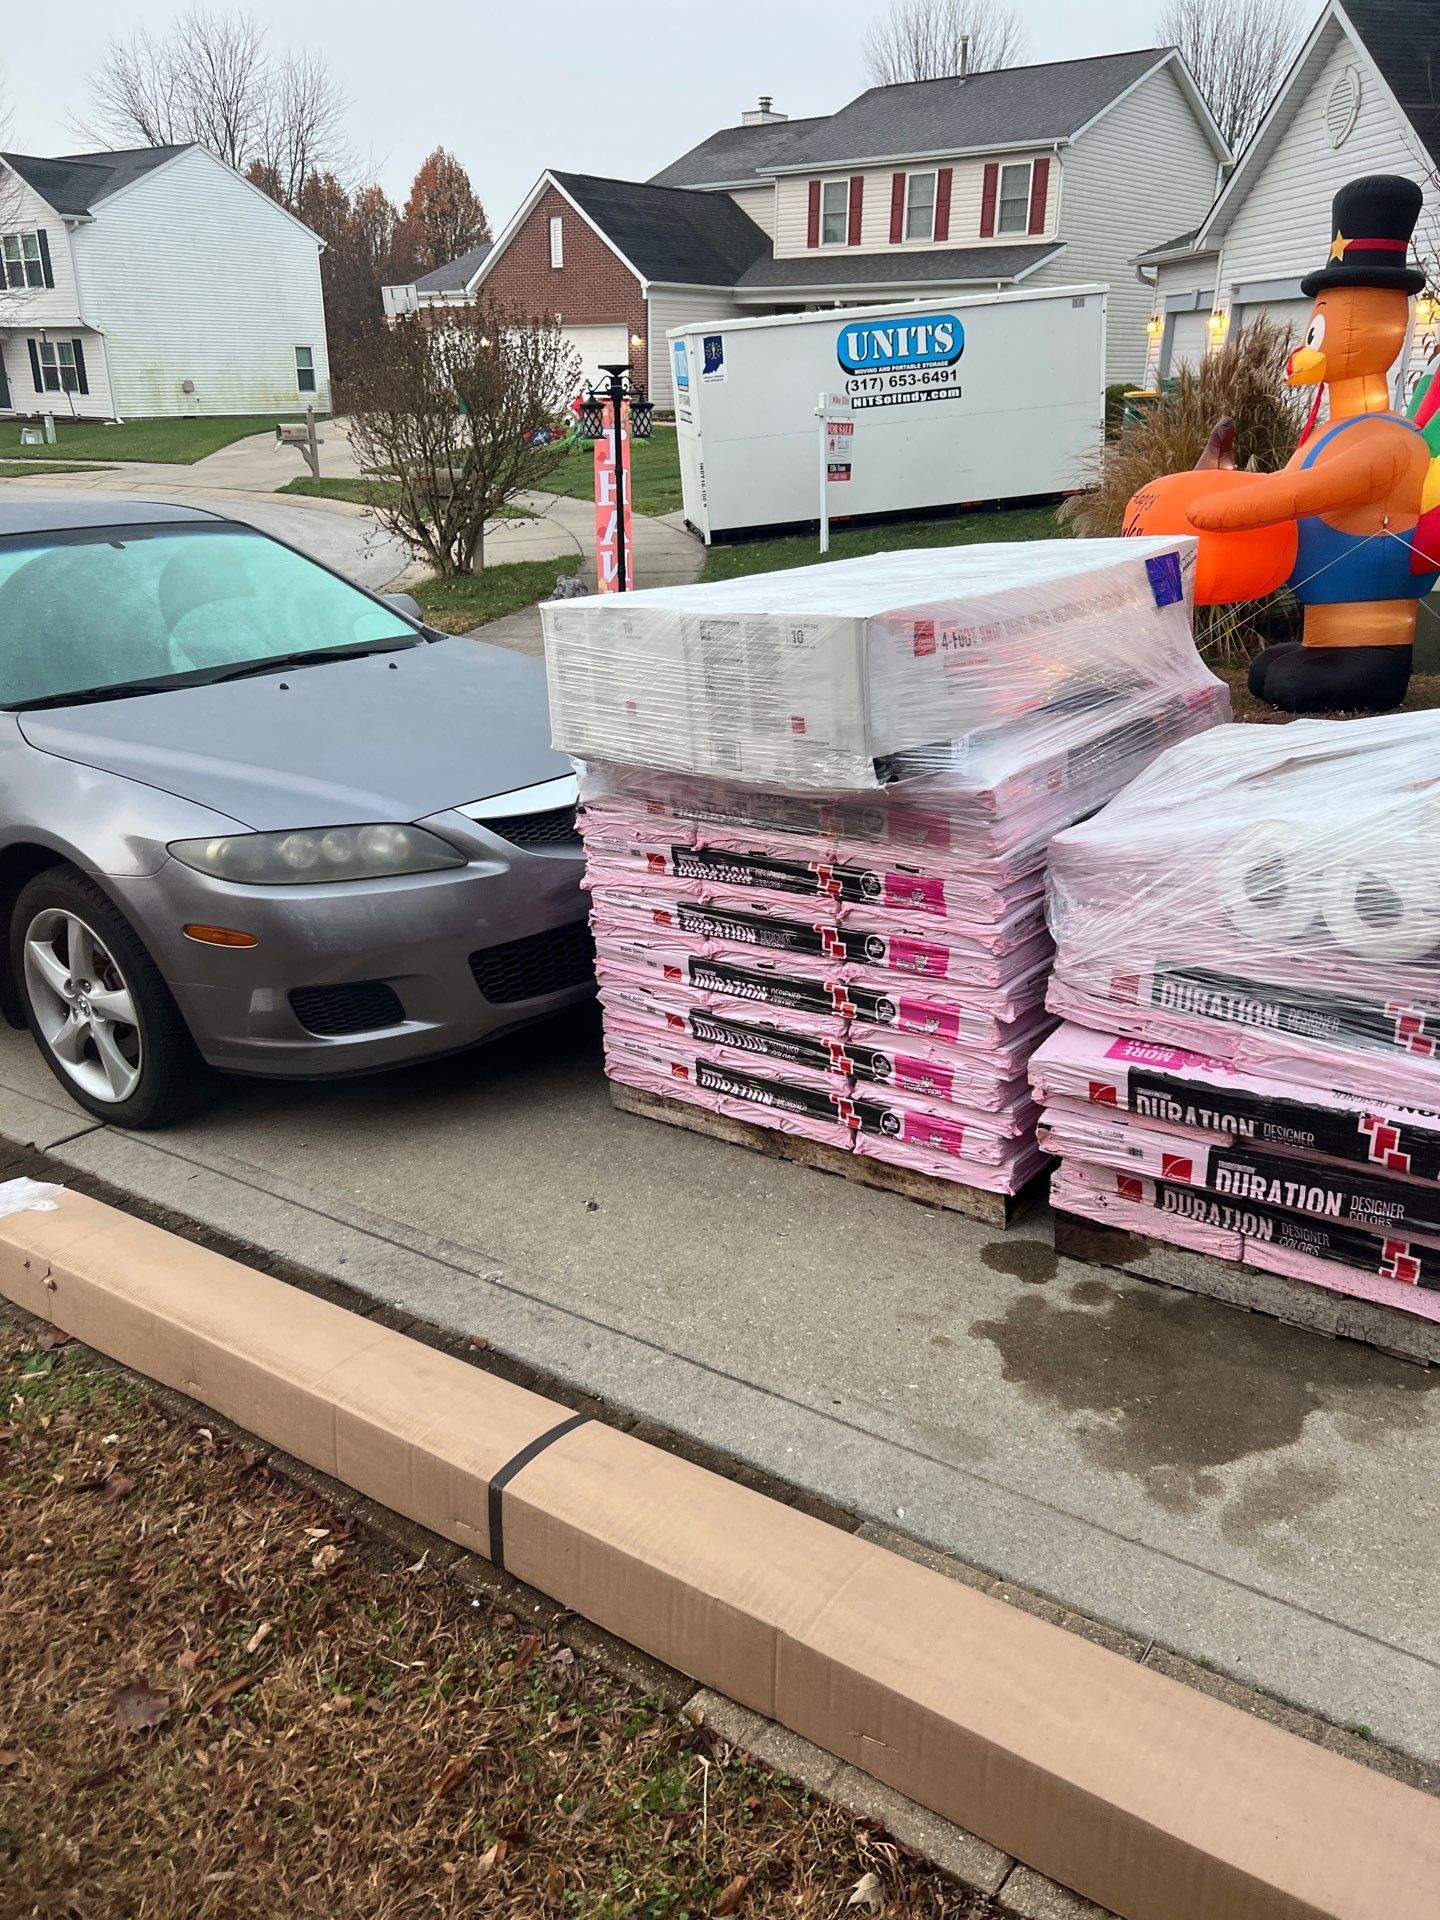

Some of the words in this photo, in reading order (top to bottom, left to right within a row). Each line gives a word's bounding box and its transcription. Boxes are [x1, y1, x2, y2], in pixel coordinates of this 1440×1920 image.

[846, 321, 954, 361] UNITS
[845, 377, 884, 395] (317)
[888, 369, 958, 388] 653-6491
[854, 367, 878, 376] MOVING
[879, 366, 891, 374] AND
[891, 363, 921, 373] PORTABLE
[921, 360, 949, 370] STORAGE
[853, 387, 960, 408] NITSofIndy.com
[677, 859, 754, 884] DURATION
[683, 915, 757, 944] DURATION
[694, 973, 769, 1001] DURATION
[1161, 979, 1280, 1027] DURATION
[696, 1020, 769, 1053] DURATION
[1122, 1044, 1175, 1063] MORE
[701, 1073, 774, 1105] DURATION
[1136, 1093, 1256, 1138] DURATION
[1263, 1122, 1315, 1148] DESIGNER
[1215, 1168, 1343, 1217] DURATION
[1350, 1194, 1405, 1220] DESIGNER
[1162, 1189, 1274, 1242] DURATION
[1281, 1222, 1330, 1248] DESIGNER
[1349, 1210, 1392, 1229] COLORS
[1278, 1238, 1321, 1256] COLORS
